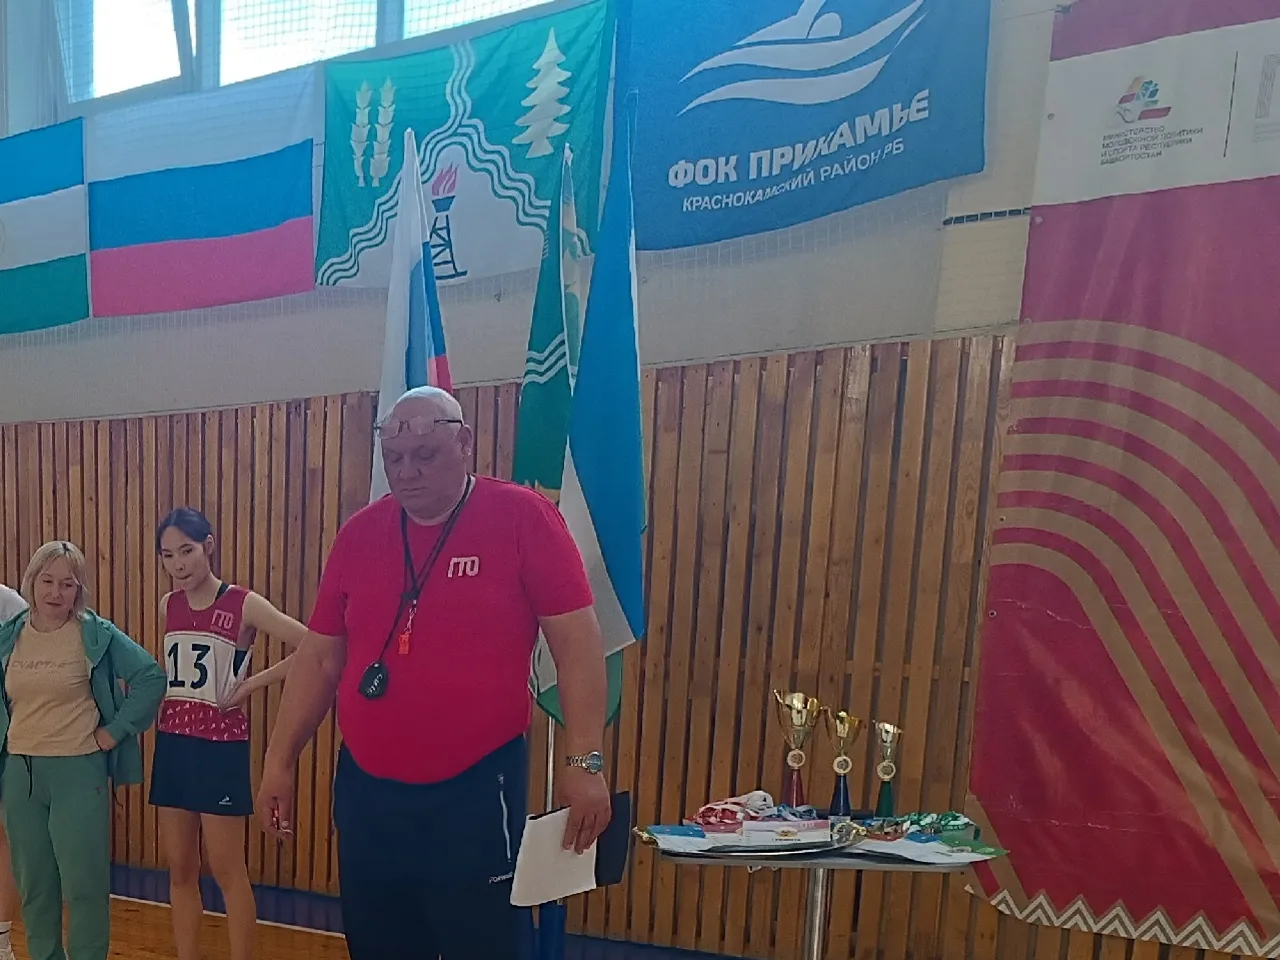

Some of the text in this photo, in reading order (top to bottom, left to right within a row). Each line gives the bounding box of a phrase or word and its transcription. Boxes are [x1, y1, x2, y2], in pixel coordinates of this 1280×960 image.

[668, 88, 930, 188] ФОК ПРИКАМЬЕ
[682, 138, 904, 212] КРАСНОКАМСКИЙ РАЙОН РБ
[447, 556, 480, 578] ГТО
[168, 642, 211, 690] 13
